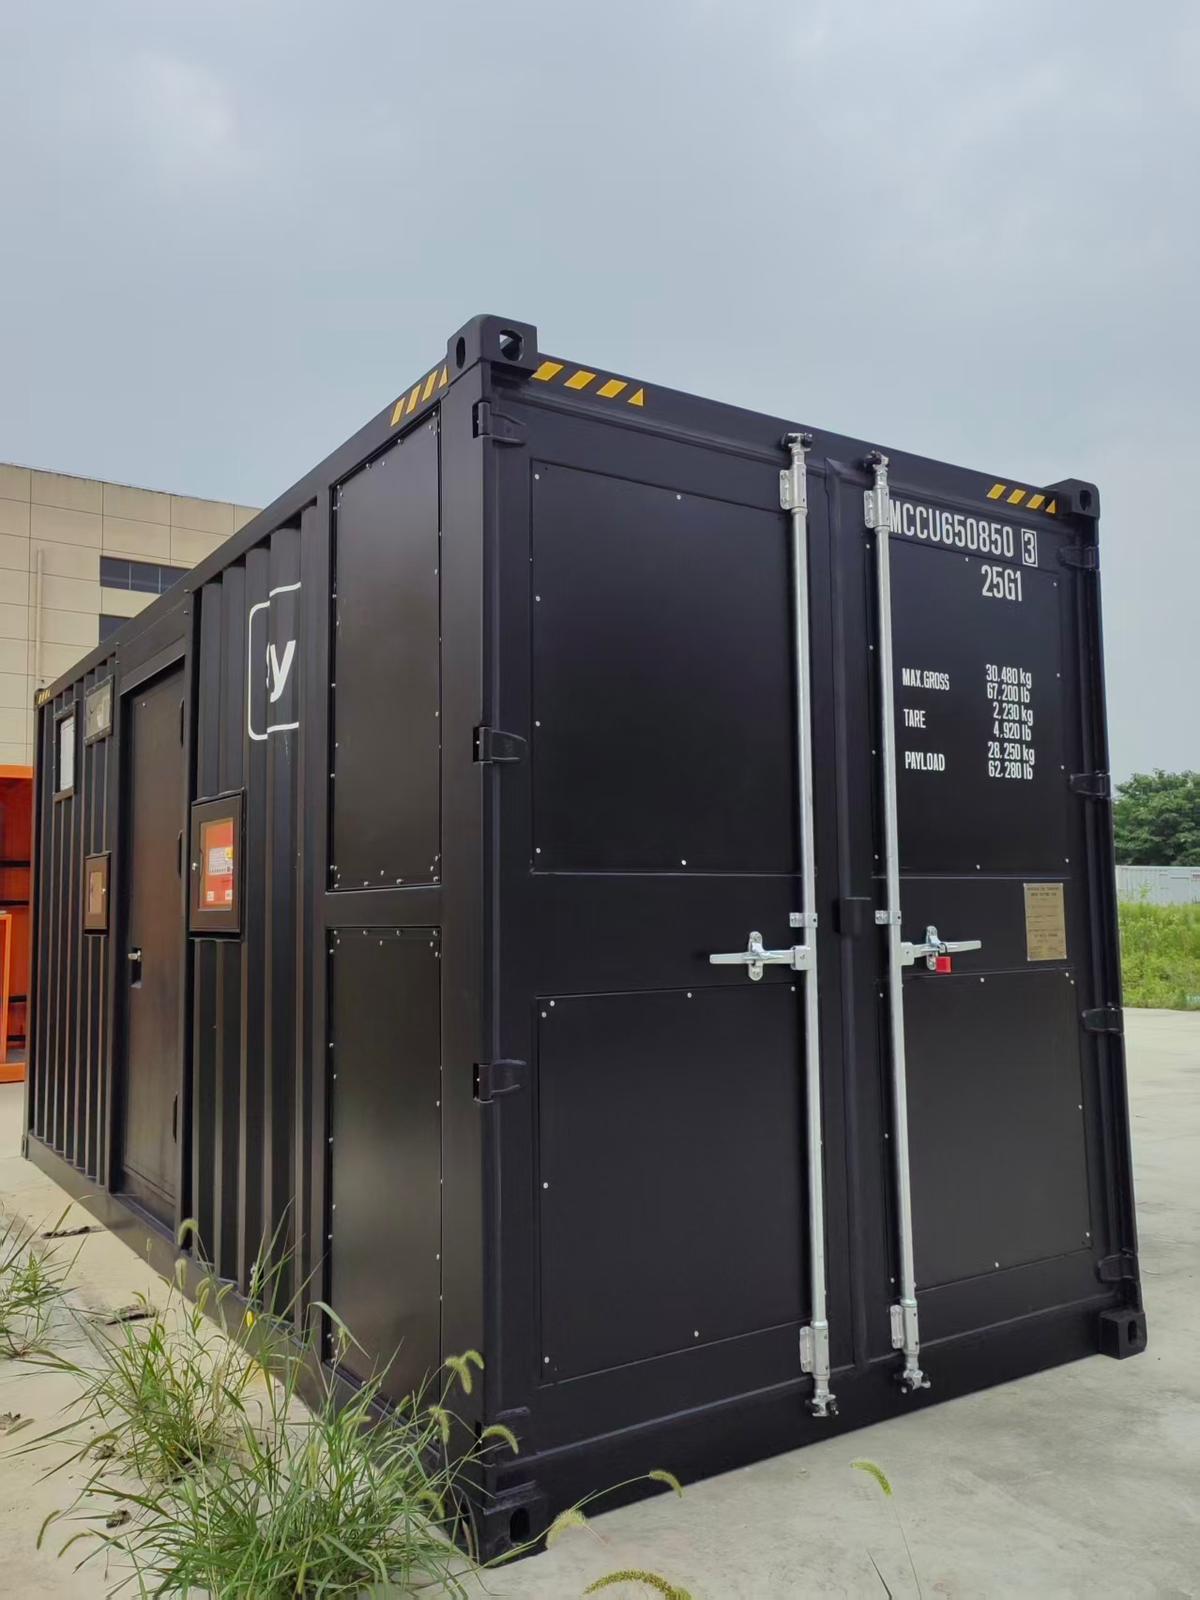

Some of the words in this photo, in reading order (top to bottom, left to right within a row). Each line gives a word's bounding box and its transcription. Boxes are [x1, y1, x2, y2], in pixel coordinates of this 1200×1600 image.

[889, 499, 1014, 557] MCCU650850
[1024, 532, 1035, 563] 3
[981, 564, 1022, 602] 25G1
[1020, 667, 1032, 689] kg
[1020, 686, 1030, 703] lb
[903, 708, 926, 729] TARE
[1021, 705, 1033, 726] kg
[1022, 724, 1031, 741] lb
[905, 751, 946, 772] PAYLOAD
[1023, 744, 1035, 766] kg
[1023, 763, 1033, 780] lb
